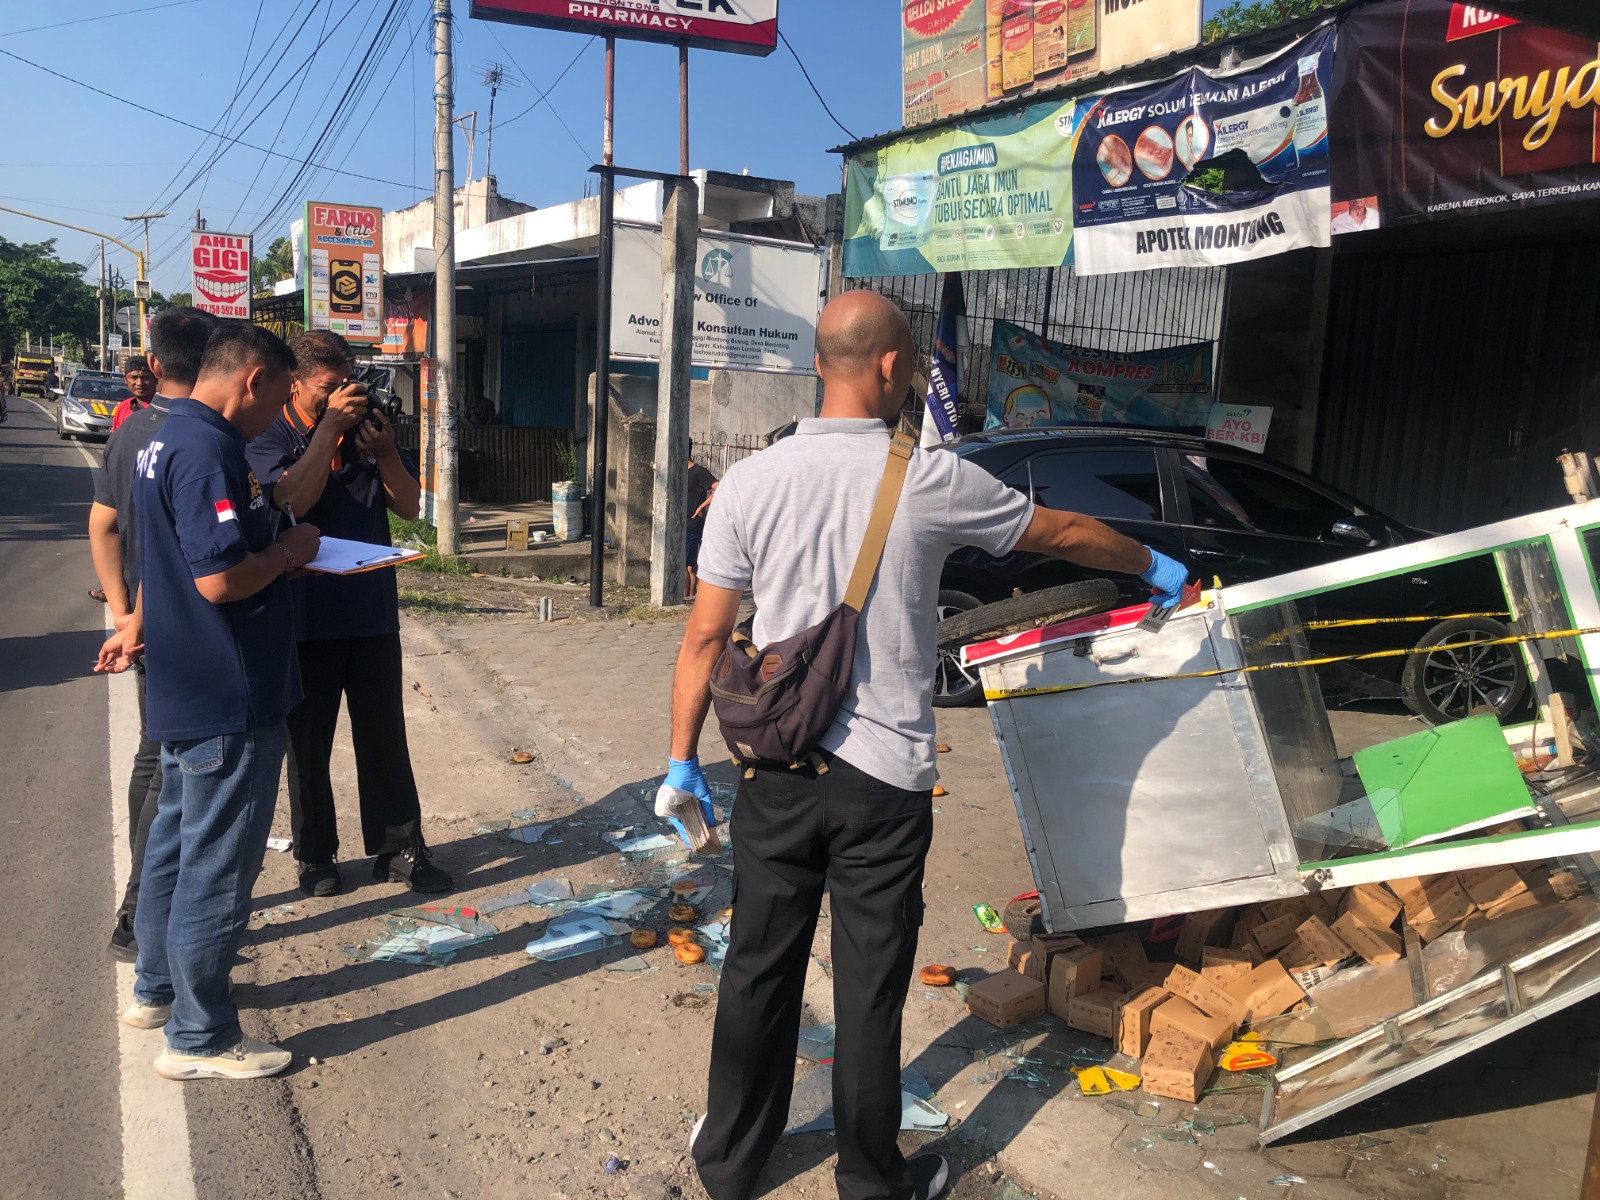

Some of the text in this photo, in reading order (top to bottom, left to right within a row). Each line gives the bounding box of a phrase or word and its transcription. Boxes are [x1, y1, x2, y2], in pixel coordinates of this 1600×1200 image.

[568, 3, 693, 30] PHARMACY
[905, 104, 939, 126] DEMAM
[964, 174, 990, 195] JAGA
[994, 169, 1018, 192] IMUN
[893, 196, 918, 208] STIMUNO
[963, 197, 1003, 219] SECARA
[1007, 190, 1053, 215] OPTIMAL
[1427, 201, 1461, 212] KARENA
[1462, 194, 1510, 208] MEROKOK,
[1511, 191, 1536, 201] SAYA
[1537, 185, 1581, 198] TERKENA
[314, 207, 377, 234] FARUQ
[334, 227, 342, 236] &
[198, 235, 243, 250] AHLI
[317, 235, 362, 246] ACCESORIES
[1136, 211, 1286, 254] APOTEK MONTONG
[193, 247, 248, 271] GIGI
[221, 305, 233, 315] 592
[234, 306, 247, 317] 689
[705, 293, 741, 306] Office
[744, 297, 758, 308] Of
[628, 314, 799, 341] Advo Konsultan Hukum
[712, 344, 741, 352] Kabupaten
[1067, 358, 1155, 380] KOMPRES
[930, 367, 951, 401] NYERI
[1206, 429, 1265, 444] BER-KB!
[1222, 419, 1252, 432] AYO
